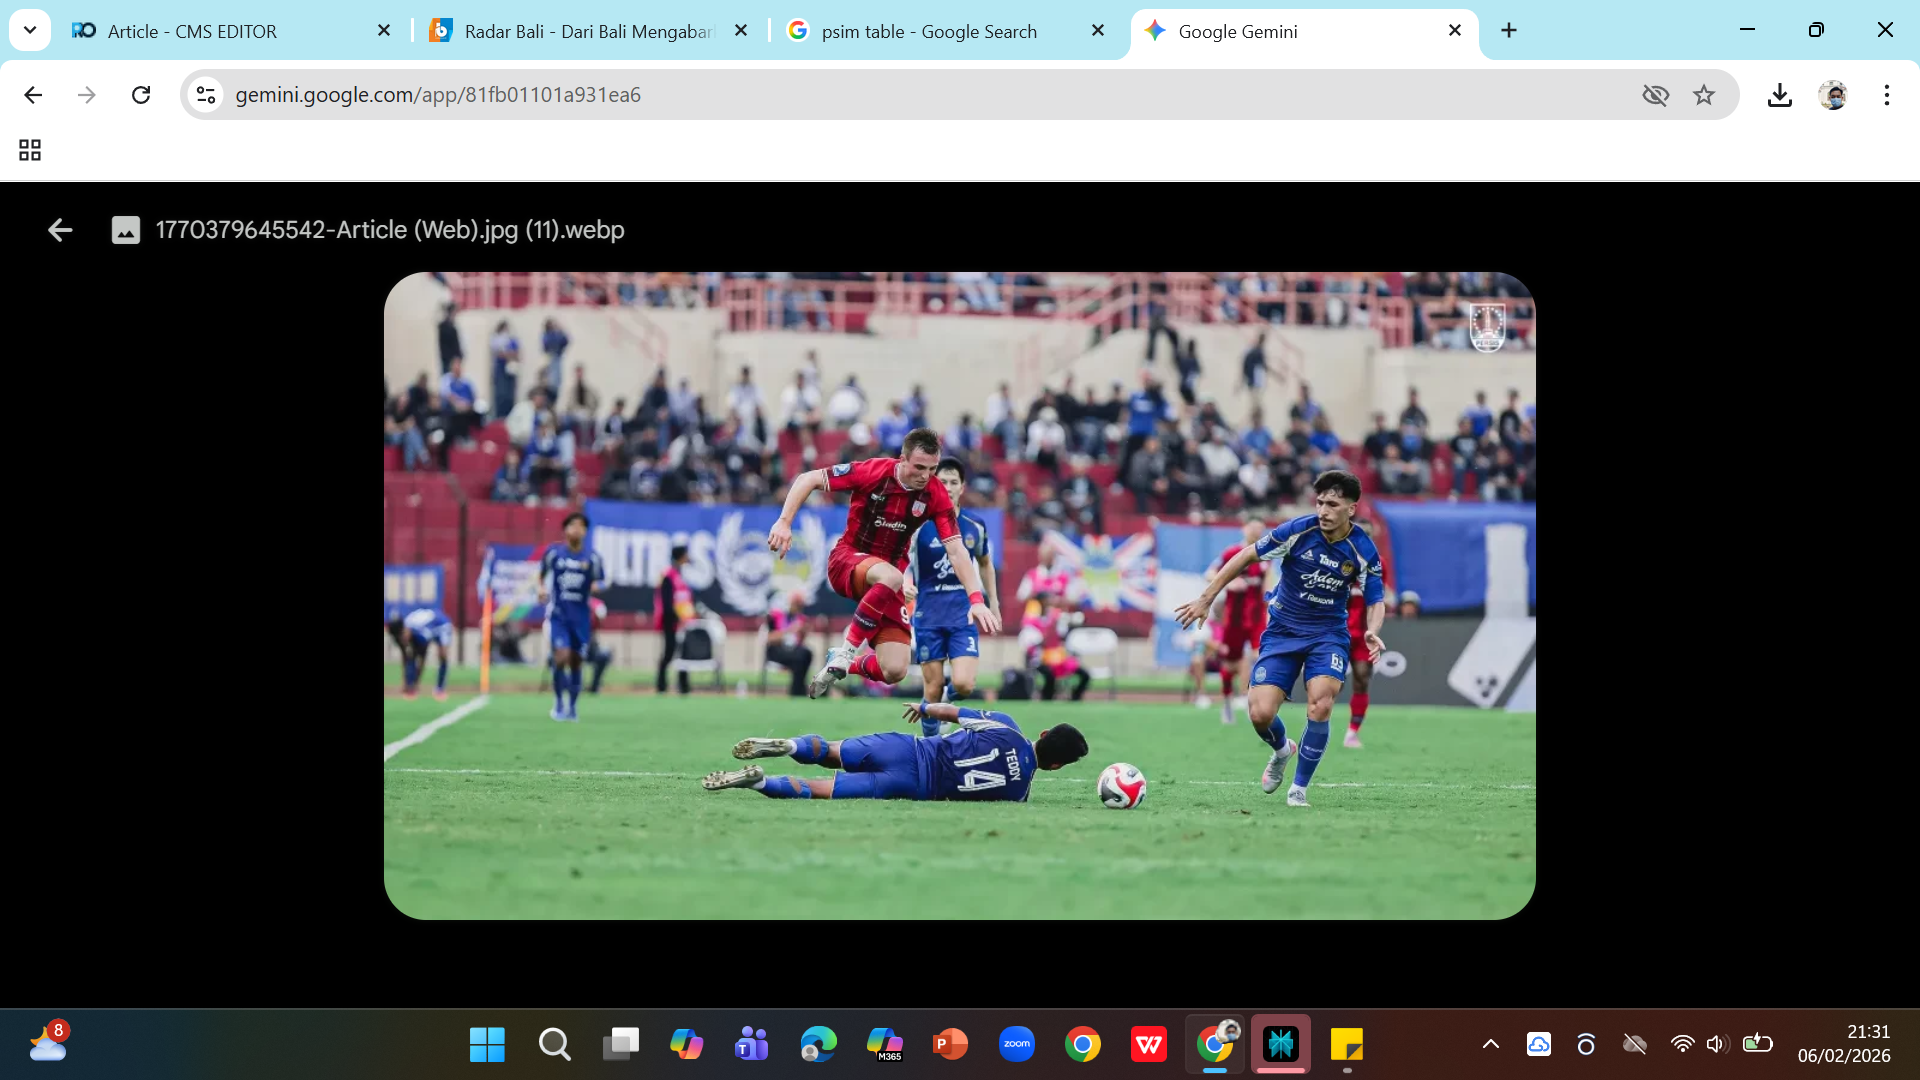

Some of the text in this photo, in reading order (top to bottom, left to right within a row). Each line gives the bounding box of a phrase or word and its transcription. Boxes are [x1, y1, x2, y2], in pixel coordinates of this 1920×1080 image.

[108, 24, 158, 39] Article
[176, 25, 213, 39] CMS
[218, 25, 278, 39] EDITOR
[466, 24, 511, 39] Radar
[517, 24, 544, 39] Bali
[563, 24, 594, 39] Dari
[600, 24, 627, 39] Bali
[633, 24, 716, 43] Mengabar
[823, 25, 860, 43] psim
[865, 24, 905, 39] table
[921, 24, 979, 43] Google
[985, 24, 1038, 39] Search
[1179, 24, 1298, 43] Google Gemini
[235, 86, 642, 108] gemini.google.com/app/81fb01101a931ea6
[156, 219, 626, 244] 1770379645542-Article (Web).jpg (11).webp
[1319, 553, 1339, 568] Taro
[900, 605, 910, 624] 9
[967, 636, 975, 649] 3
[953, 748, 1006, 792] 14
[1005, 748, 1021, 781] TEDDY
[54, 1023, 64, 1037] 8
[1847, 1024, 1890, 1039] 21:31
[1004, 1040, 1031, 1048] zoom
[878, 1053, 902, 1061] M365
[1797, 1048, 1892, 1065] 06/02/2026
